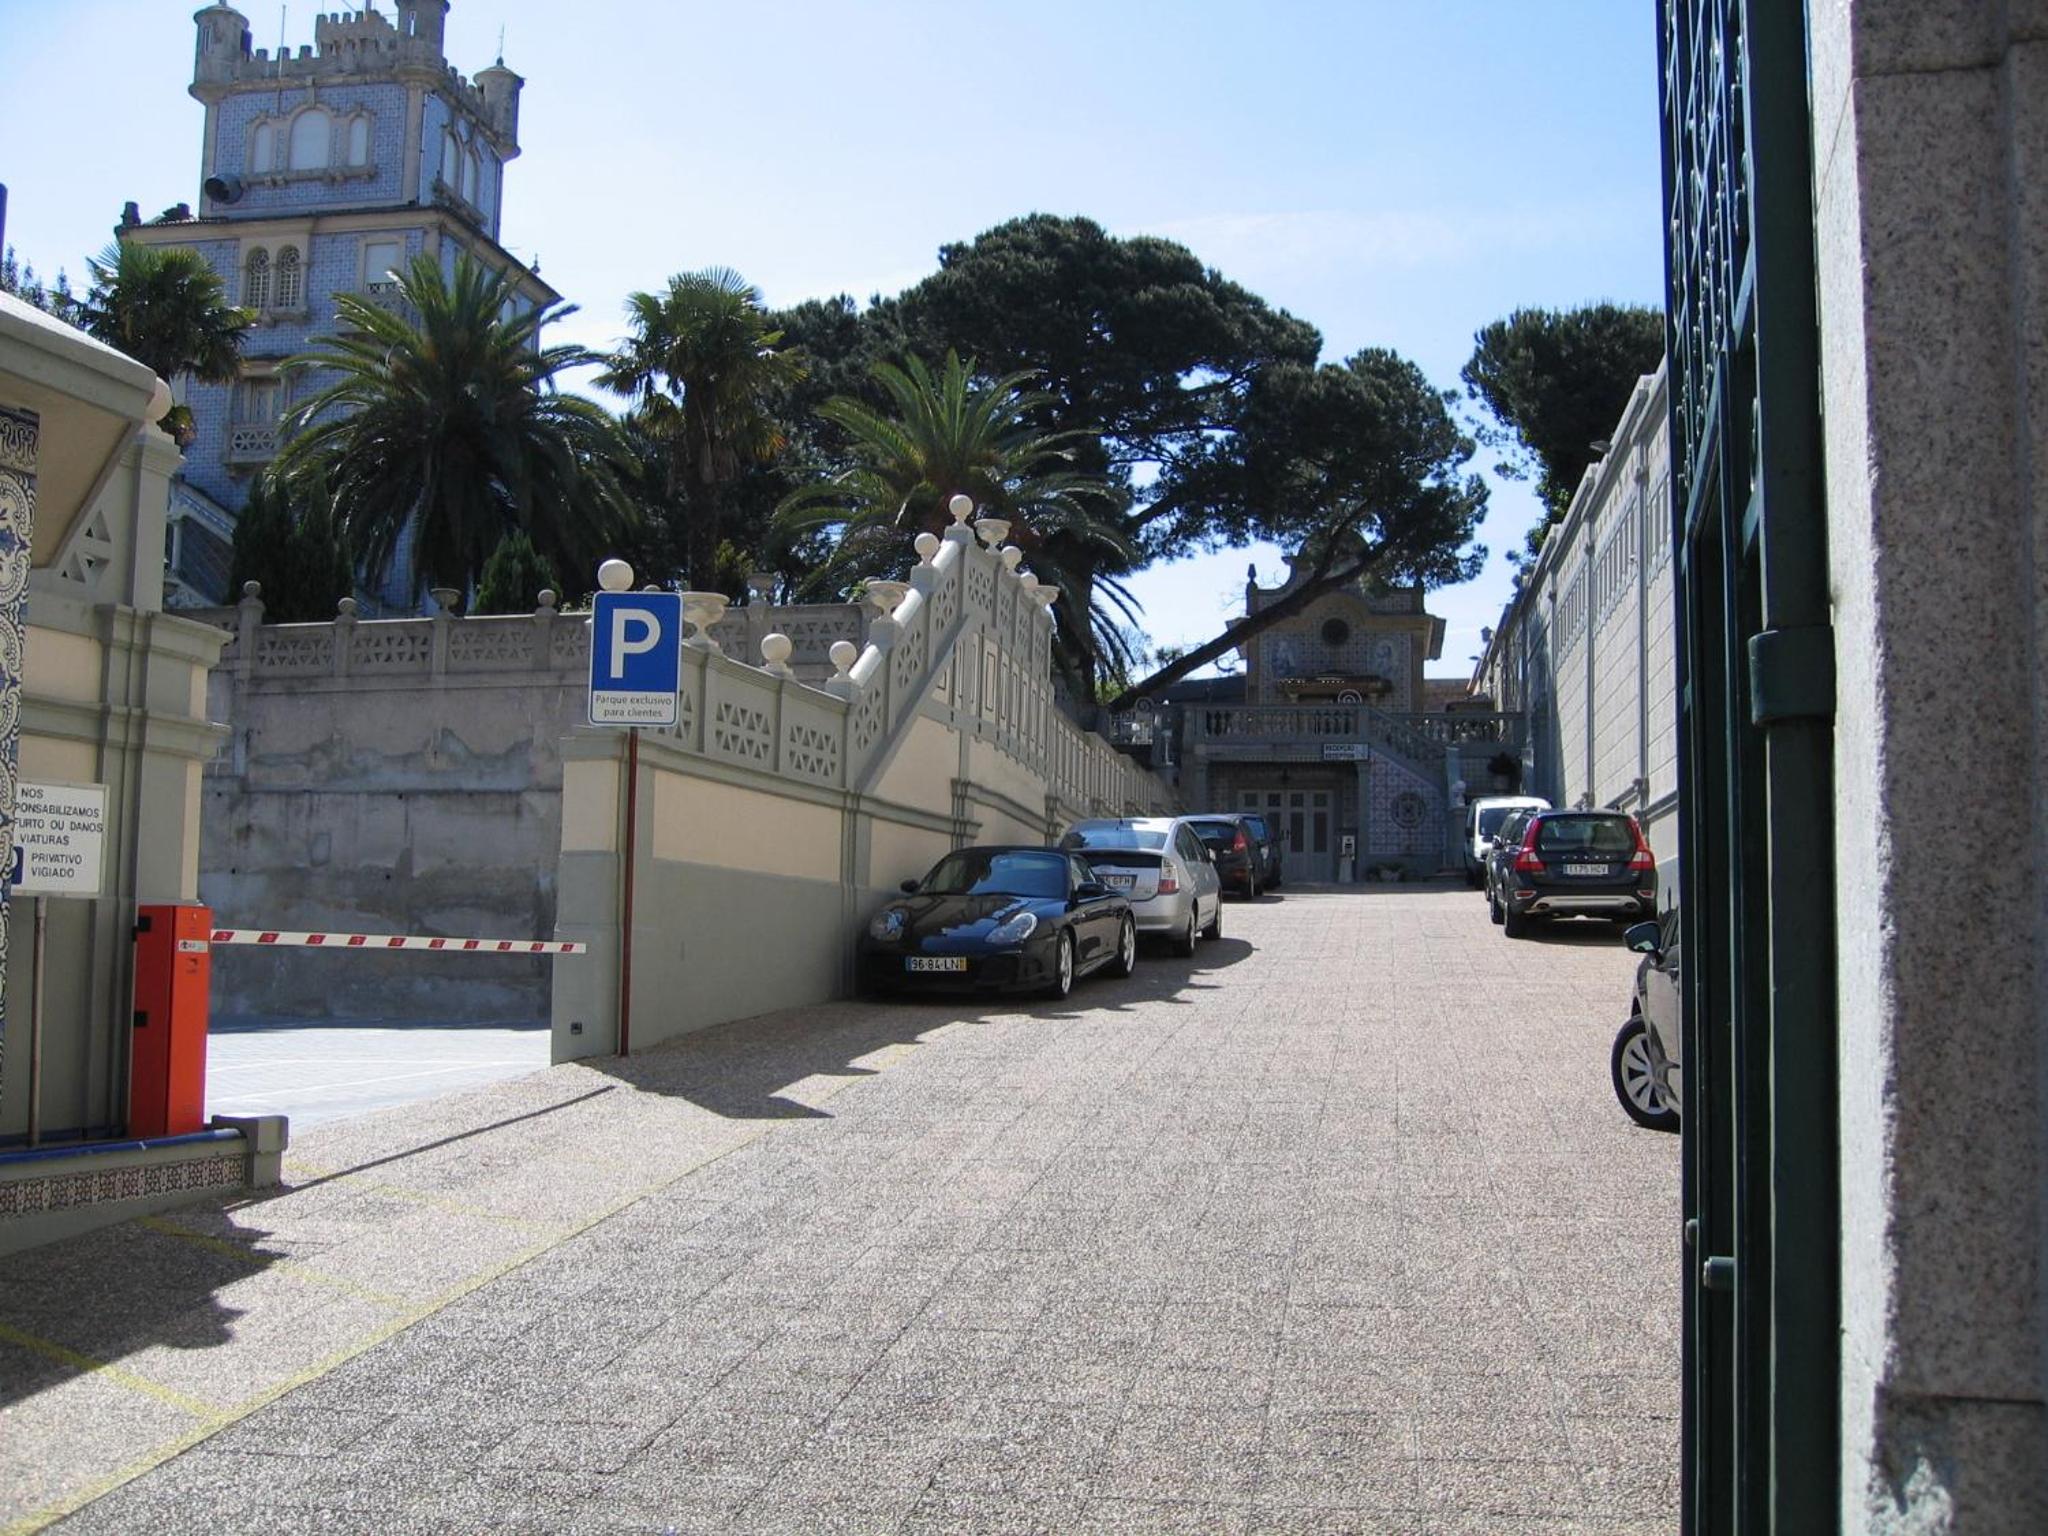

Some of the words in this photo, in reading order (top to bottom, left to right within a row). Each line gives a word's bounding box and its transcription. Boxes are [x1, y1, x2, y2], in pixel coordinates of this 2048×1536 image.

[610, 608, 662, 679] P
[595, 694, 629, 706] Parque
[630, 695, 673, 706] exclusivo
[603, 709, 625, 719] para
[627, 707, 663, 718] clientes
[21, 788, 44, 798] NOS
[50, 820, 65, 831] OU
[70, 821, 104, 833] DANOS
[20, 834, 70, 846] VIATURAS
[31, 852, 83, 865] PRIVATIVO
[31, 867, 75, 878] VIGIADO
